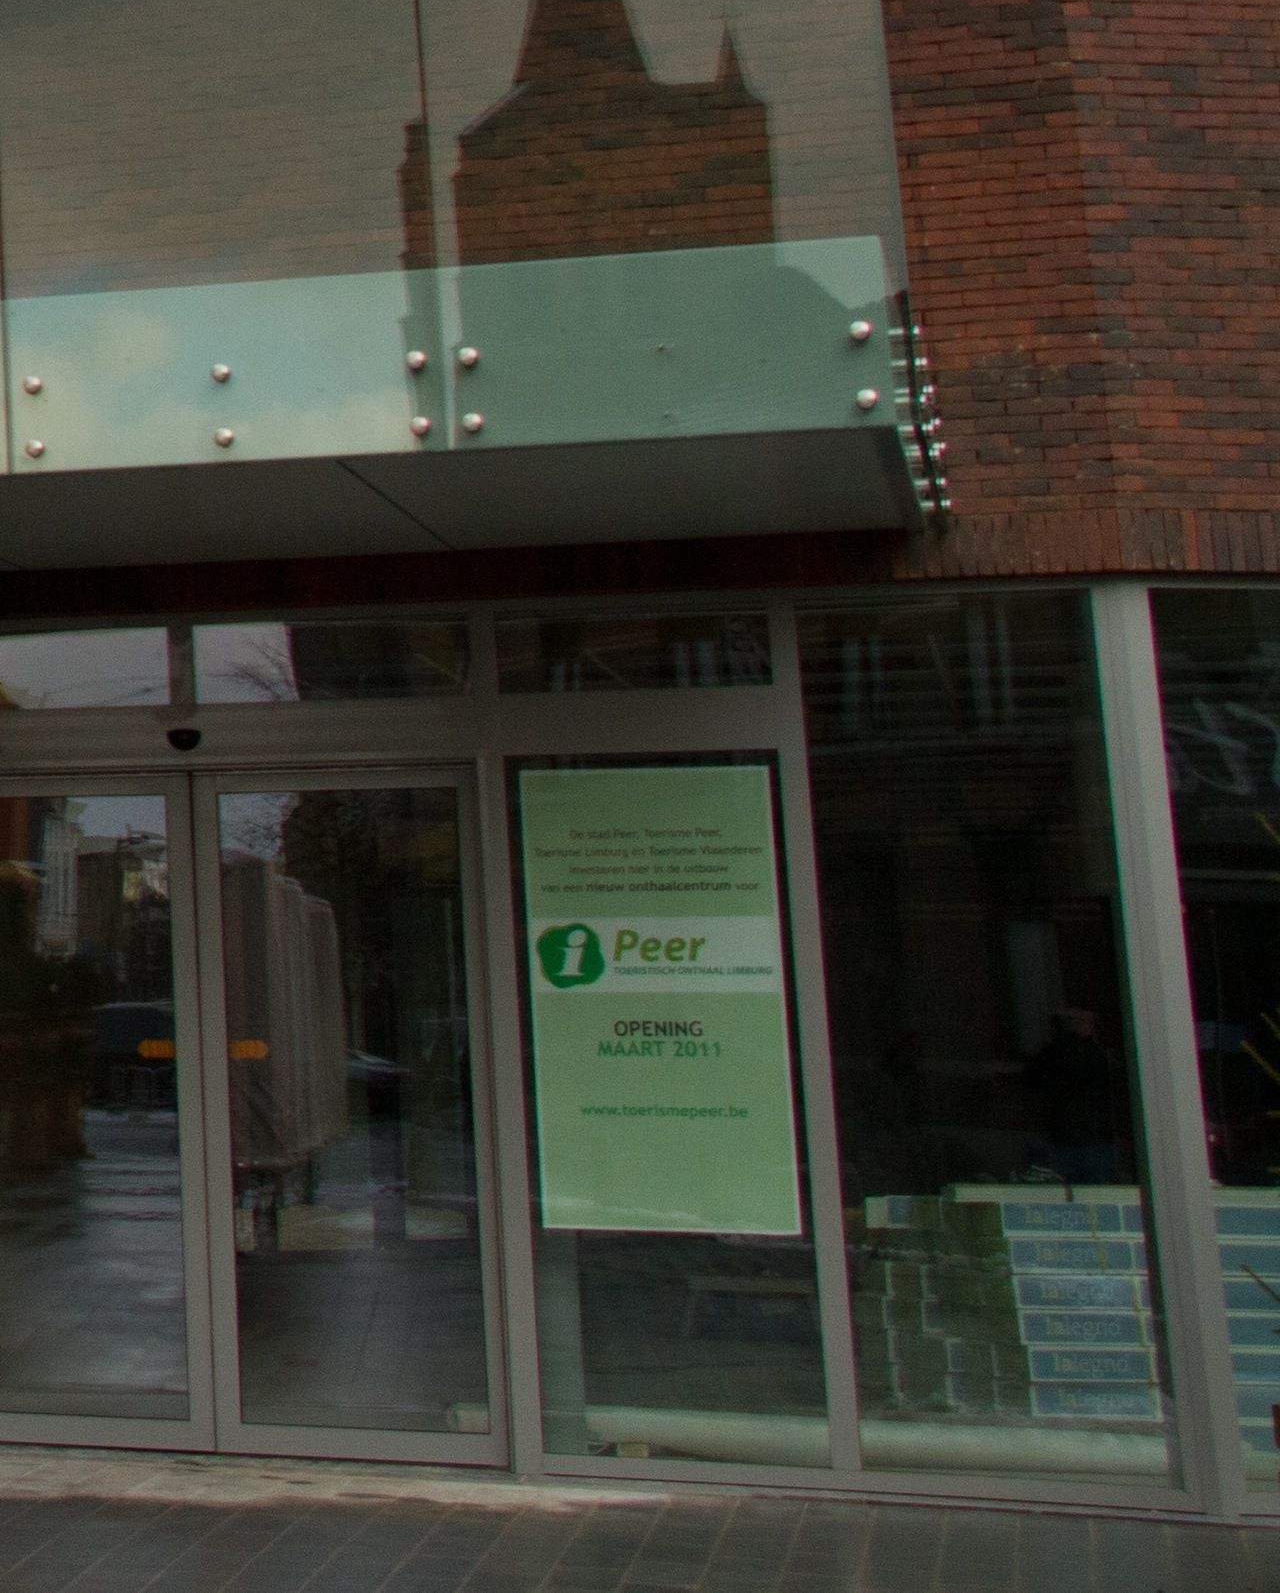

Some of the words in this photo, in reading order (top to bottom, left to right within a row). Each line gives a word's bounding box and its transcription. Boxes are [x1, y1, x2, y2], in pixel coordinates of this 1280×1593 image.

[585, 846, 628, 859] Limburg
[649, 845, 696, 856] Toerisme
[700, 844, 763, 856] Vlaanderen
[684, 862, 729, 874] uitbouw
[541, 883, 560, 893] van
[563, 883, 583, 893] een
[586, 881, 625, 893] nieuw
[629, 880, 732, 892] onthaalcentrum
[735, 882, 759, 892] voor
[613, 929, 705, 962] Peer
[614, 966, 676, 976] TOERISTISCH
[678, 966, 724, 976] ONTHAAL
[726, 965, 774, 976] LIMBURG
[613, 1020, 704, 1038] OPENING
[596, 1040, 666, 1058] MAART
[673, 1040, 722, 1058] 2011
[579, 1104, 749, 1120] www.toerismepeer.be
